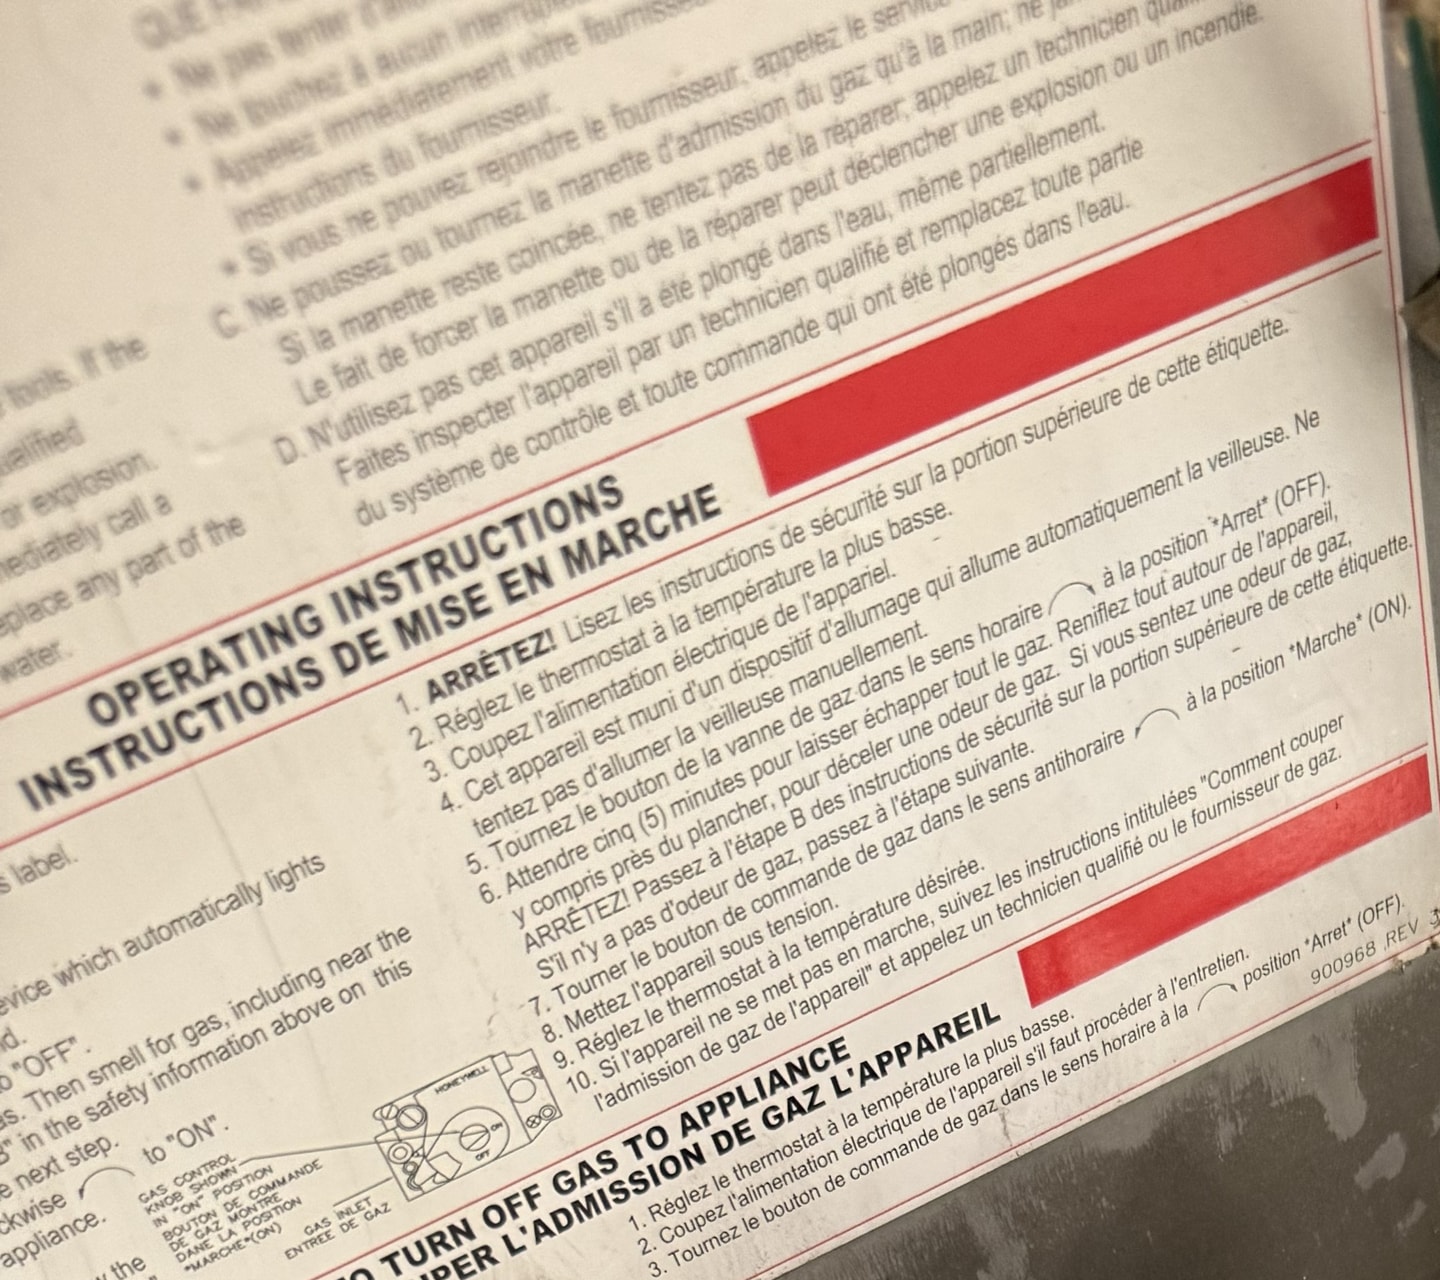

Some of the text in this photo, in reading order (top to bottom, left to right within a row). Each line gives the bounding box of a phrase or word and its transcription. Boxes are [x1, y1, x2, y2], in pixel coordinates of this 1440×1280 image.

[84, 473, 625, 729] OPERATING INSTRUCTIONS
[395, 310, 1292, 716] 1. ARRÊTEZ! Lisez les instructions de sécurité sur la portion supérieure de cette étiquette.
[15, 481, 723, 813] INSTRUCTIONS DE MISE EN MARCHE
[51, 854, 327, 988] which automatically lights
[565, 1069, 598, 1095] 10.
[597, 1054, 622, 1079] Si
[619, 1014, 706, 1070] l'appareil
[706, 1006, 734, 1030] ne
[735, 993, 760, 1016] se
[760, 970, 800, 1004] met
[798, 957, 835, 991] pas
[836, 945, 861, 967] en
[862, 912, 936, 956] marche,
[937, 881, 996, 920] suivez
[994, 868, 1024, 893] les
[1024, 821, 1122, 879] instructions
[1123, 785, 1198, 832] intitulées
[1289, 713, 1345, 753] couper
[1242, 947, 1301, 991] position
[1310, 935, 1377, 985] 900968
[1386, 918, 1419, 949] REV
[137, 1153, 237, 1204] GAS CONTROL
[143, 1164, 240, 1216] KNOB SHOWN
[377, 1216, 478, 1278] TURN
[481, 1182, 543, 1230] OFF
[551, 1148, 620, 1197] GAS
[620, 1125, 670, 1162] TO
[679, 1035, 852, 1141] APPLIANCE
[508, 1140, 710, 1258] L'ADMISSION
[708, 1116, 757, 1157] DE
[759, 1083, 828, 1137] GAZ
[828, 1001, 1002, 1100] L'APPAREIL
[628, 1008, 1075, 1232] 1. Réglez le thermostat à la température la plus basse.
[636, 948, 1250, 1257] 2. Coupez l'alimentation électrique de l'appareil s'il faut procéder à l'entretien.
[283, 1201, 393, 1261] ENTREE DE GAZ
[303, 1195, 373, 1237] GAS INLET
